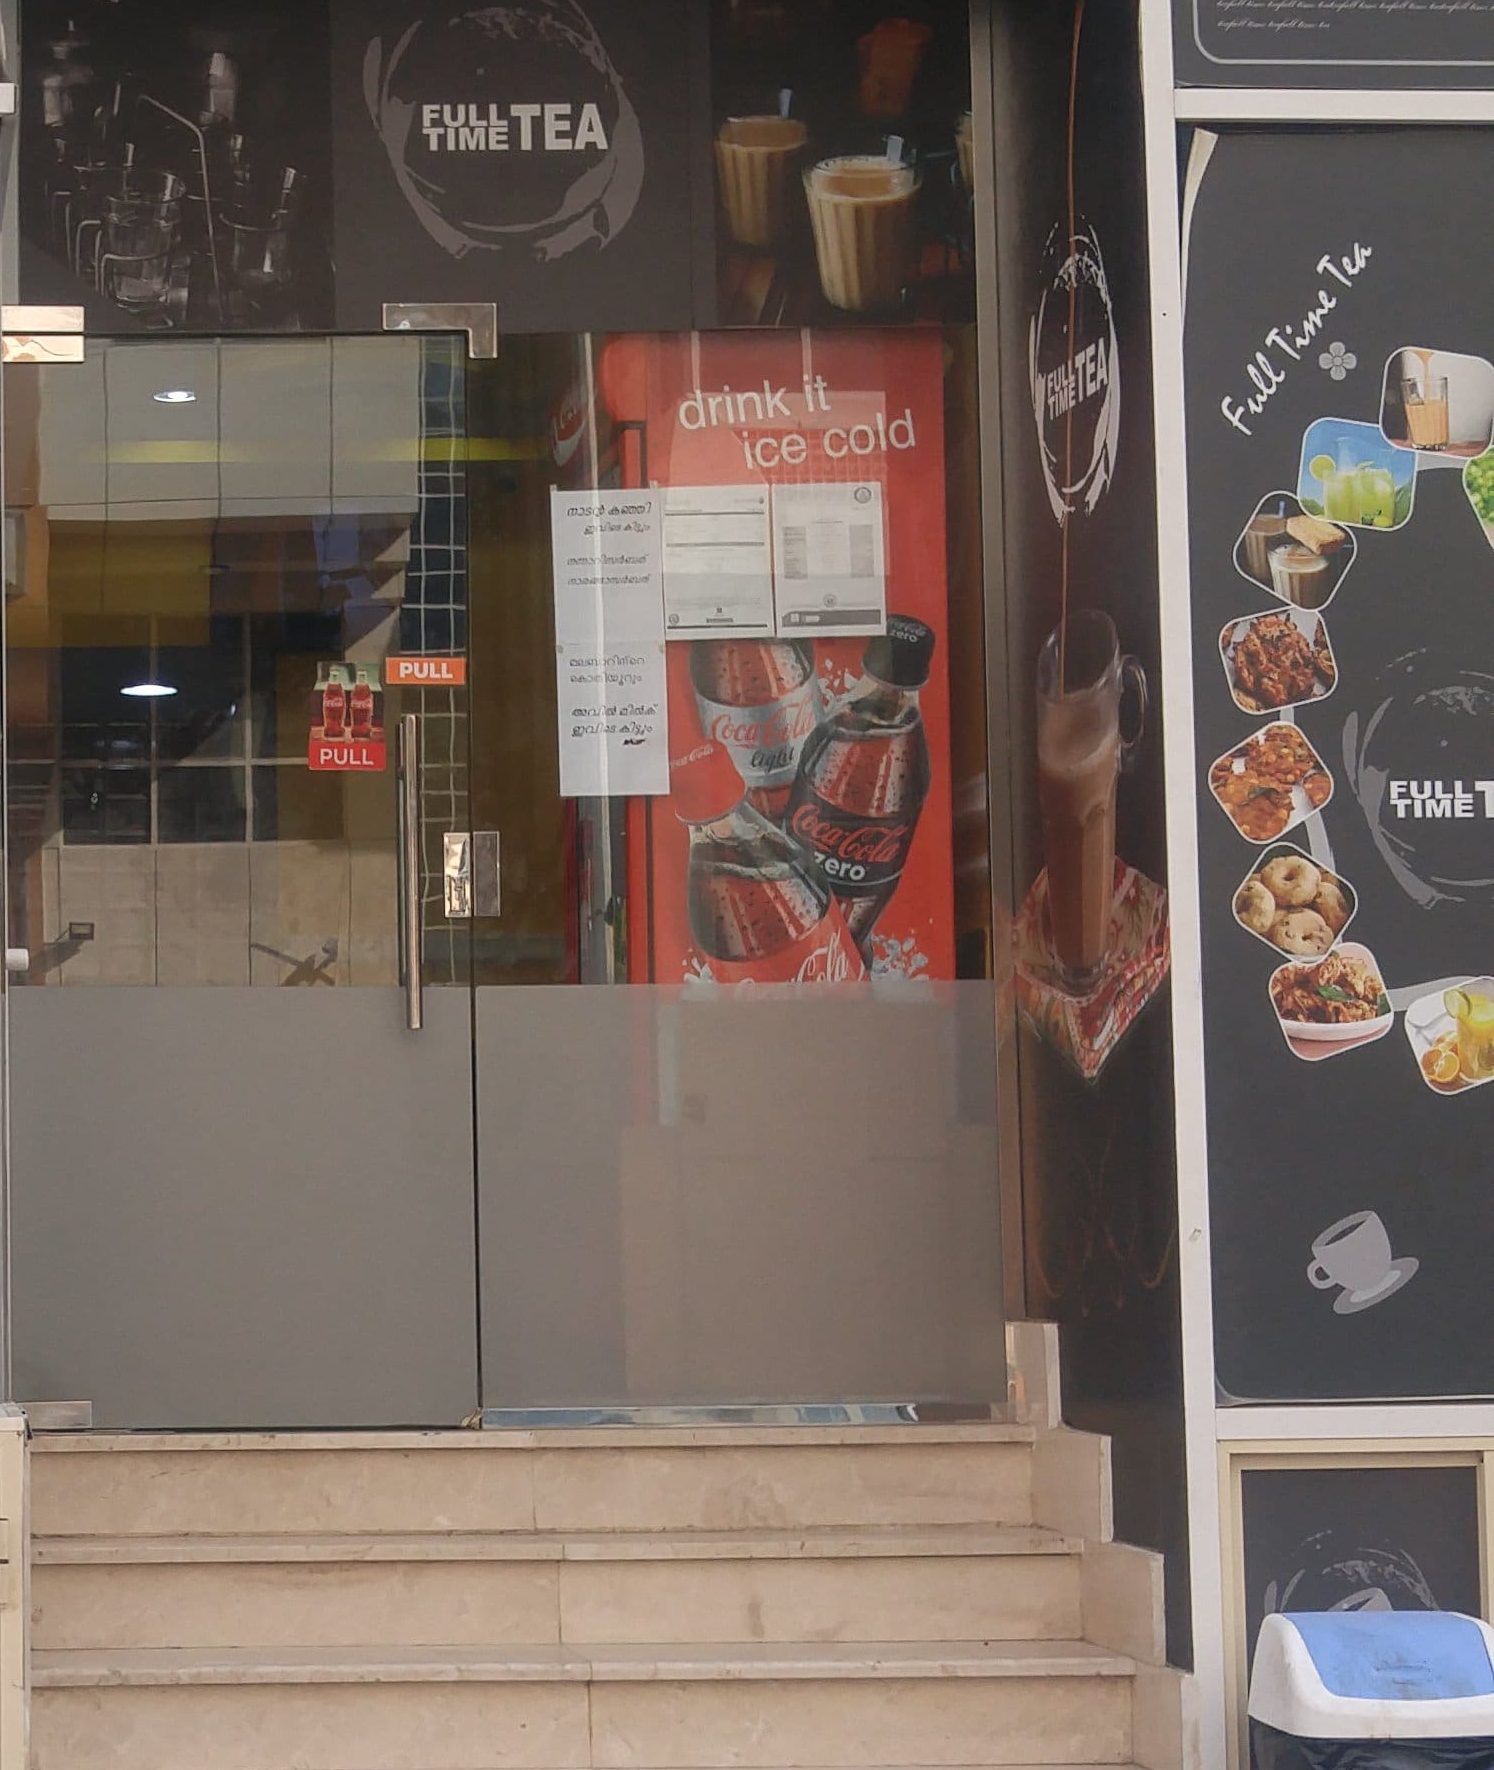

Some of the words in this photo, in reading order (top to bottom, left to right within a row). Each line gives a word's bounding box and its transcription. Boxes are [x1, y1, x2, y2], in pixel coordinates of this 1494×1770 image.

[421, 103, 508, 128] FULL
[510, 102, 609, 151] TEA
[421, 127, 509, 152] TIME
[1220, 350, 1286, 436] Full
[1264, 289, 1337, 361] Time
[1316, 242, 1373, 288] Tea
[1047, 359, 1075, 400] FULL
[1074, 336, 1108, 404] TEA
[678, 379, 792, 431] drink
[803, 374, 832, 413] it
[1047, 381, 1076, 421] TIME
[741, 431, 808, 470] ice
[822, 408, 917, 459] cold
[398, 661, 454, 680] PULL
[319, 747, 375, 766] PULL
[1389, 780, 1474, 800] FULL
[1389, 798, 1475, 819] TIME
